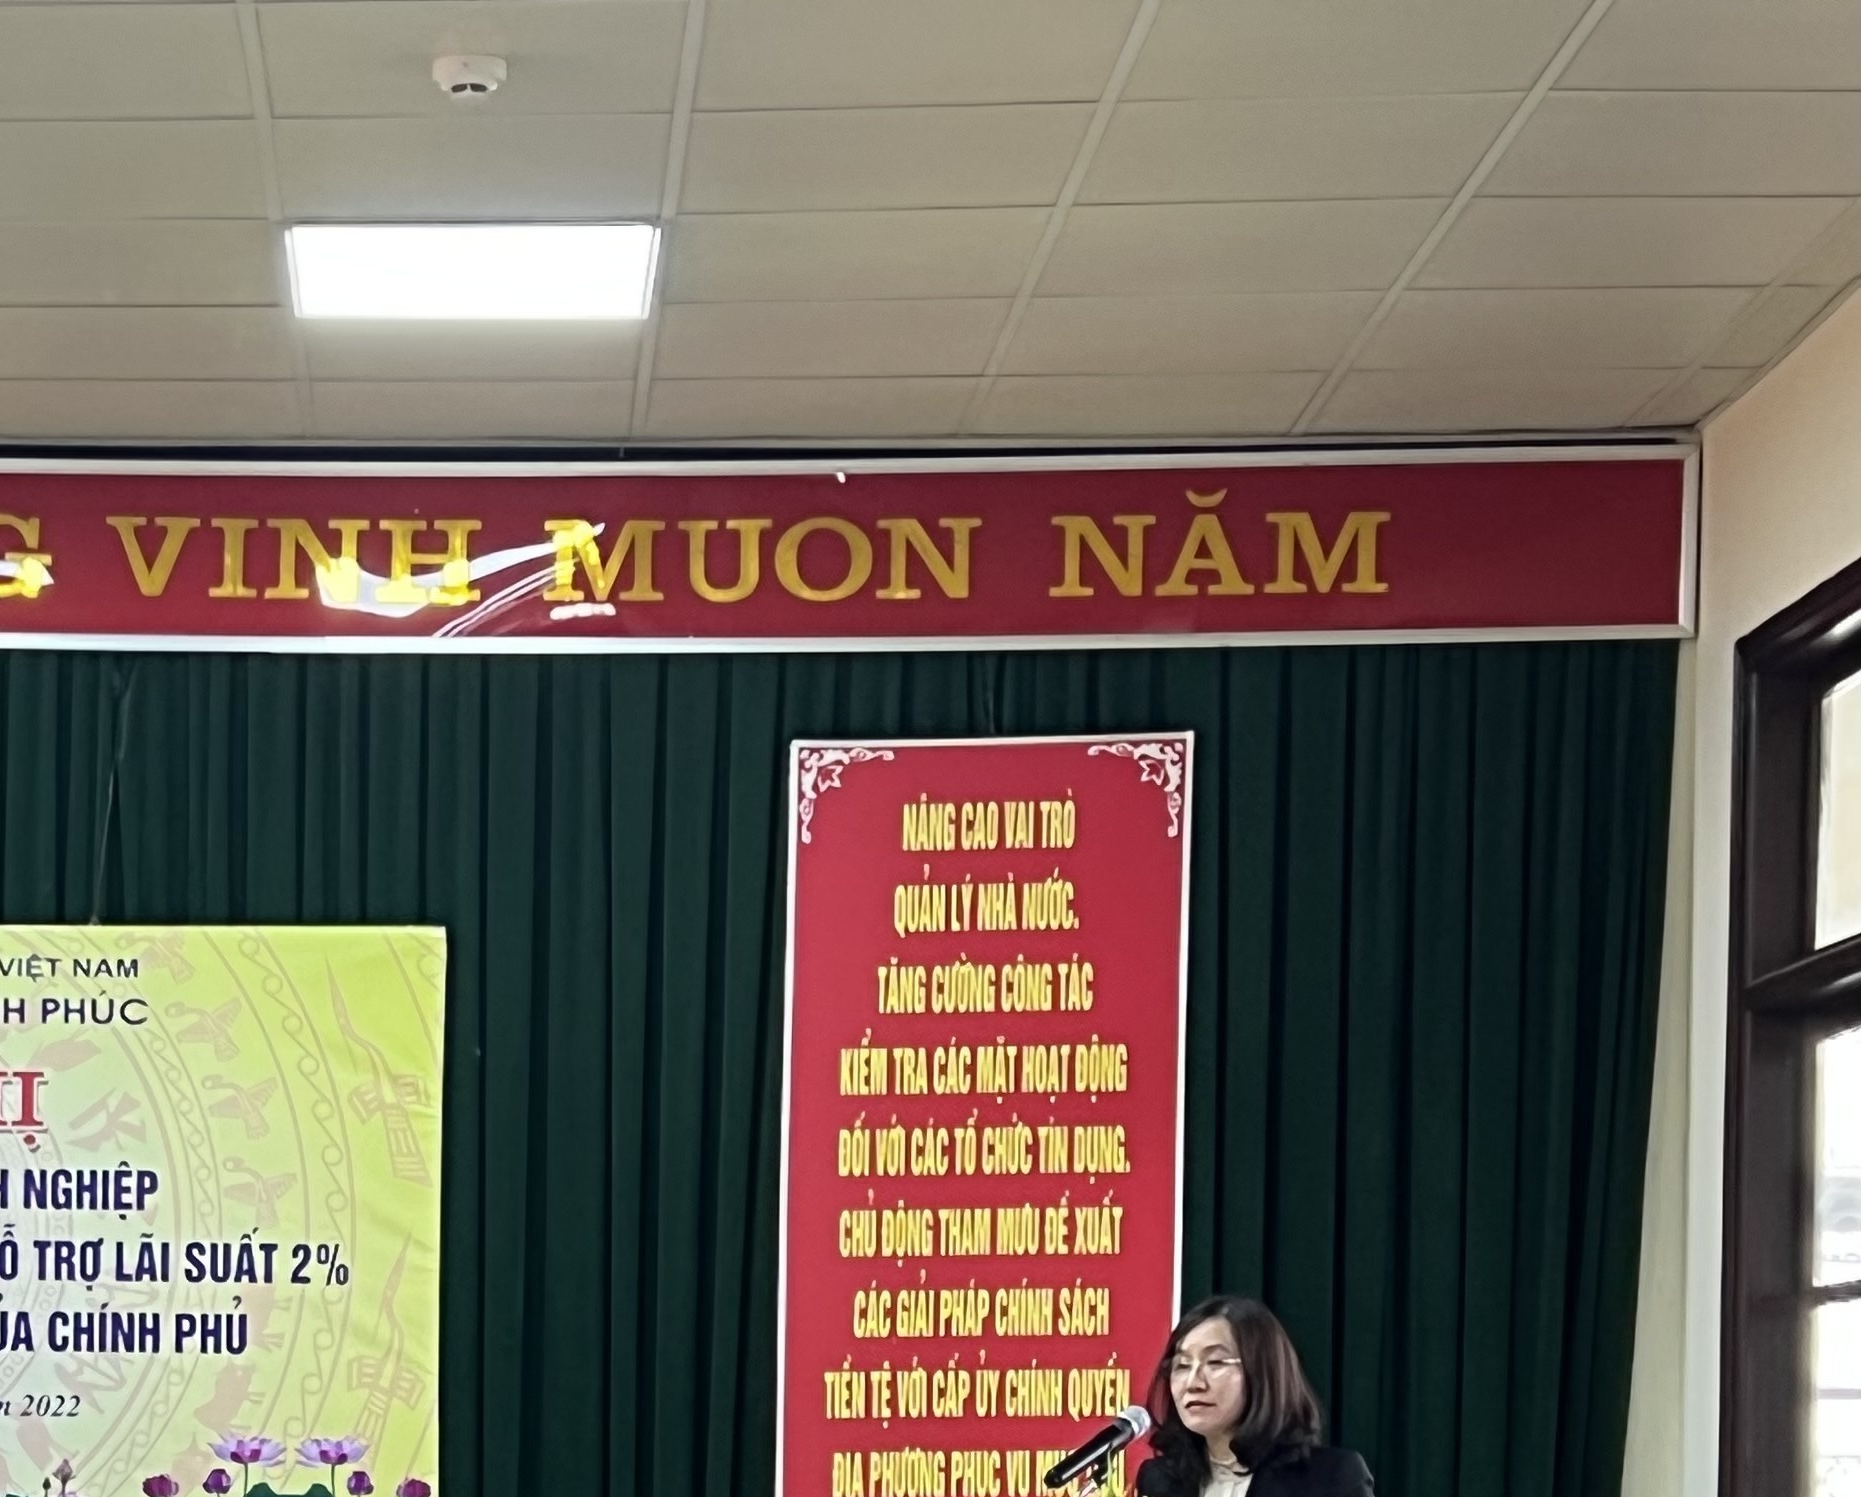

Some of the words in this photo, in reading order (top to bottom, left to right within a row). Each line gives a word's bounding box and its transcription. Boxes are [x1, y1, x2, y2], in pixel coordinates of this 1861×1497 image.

[106, 515, 482, 604] VINH
[1049, 487, 1392, 597] NĂM
[960, 802, 999, 850] CAO
[1004, 801, 1034, 849] VAI
[1040, 788, 1076, 849] TRÒ
[894, 864, 946, 938] QUẢN
[950, 873, 973, 932] LÝ
[977, 872, 1017, 931] NHÀ
[1022, 867, 1080, 930] NƯỚC.
[72, 958, 139, 979] NAM
[878, 956, 927, 1014] TĂNG
[931, 952, 996, 1013] CƯỜNG
[1001, 954, 1052, 1012] CÔNG
[1058, 952, 1095, 1011] TÁC
[40, 990, 149, 1026] PHÚC
[840, 1028, 888, 1096] KIỂM
[893, 1047, 929, 1096] TRA
[933, 1036, 972, 1095] CÁC
[976, 1035, 1018, 1105] MẶT
[1022, 1043, 1071, 1104] HOẠT
[1075, 1034, 1129, 1104] ĐỘNG
[838, 1111, 871, 1177] ĐỐI
[875, 1113, 907, 1177] VỚI
[910, 1117, 949, 1176] CÁC
[954, 1108, 977, 1176] TỔ
[982, 1112, 1033, 1175] CHỨC
[1038, 1115, 1069, 1174] TÍN
[1073, 1124, 1131, 1185] DỤNG.
[22, 1161, 158, 1221] NGHIỆP
[33, 1237, 104, 1291] TRỢ
[115, 1232, 170, 1283] LÃI
[183, 1227, 278, 1285] SUẤT
[290, 1242, 349, 1287] 2%
[839, 1188, 877, 1258] CHỦ
[881, 1199, 934, 1268] ĐỘNG
[938, 1207, 991, 1257] THAM
[996, 1202, 1041, 1257] MƯU
[1074, 1189, 1124, 1255] XUẤT
[46, 1302, 161, 1354] CHÍNH
[174, 1295, 249, 1355] PHỦ
[853, 1279, 891, 1339] CÁC
[896, 1269, 935, 1338] GIẢI
[940, 1278, 990, 1337] PHÁP
[995, 1277, 1054, 1337] CHÍNH
[1058, 1277, 1110, 1337] SÁCH
[20, 1394, 81, 1417] 2022
[870, 1360, 892, 1429] TỆ
[896, 1356, 928, 1418] VỚI
[932, 1352, 970, 1418] CẤP
[975, 1350, 1001, 1418] ỦY
[1005, 1359, 1064, 1418] CHÍNH
